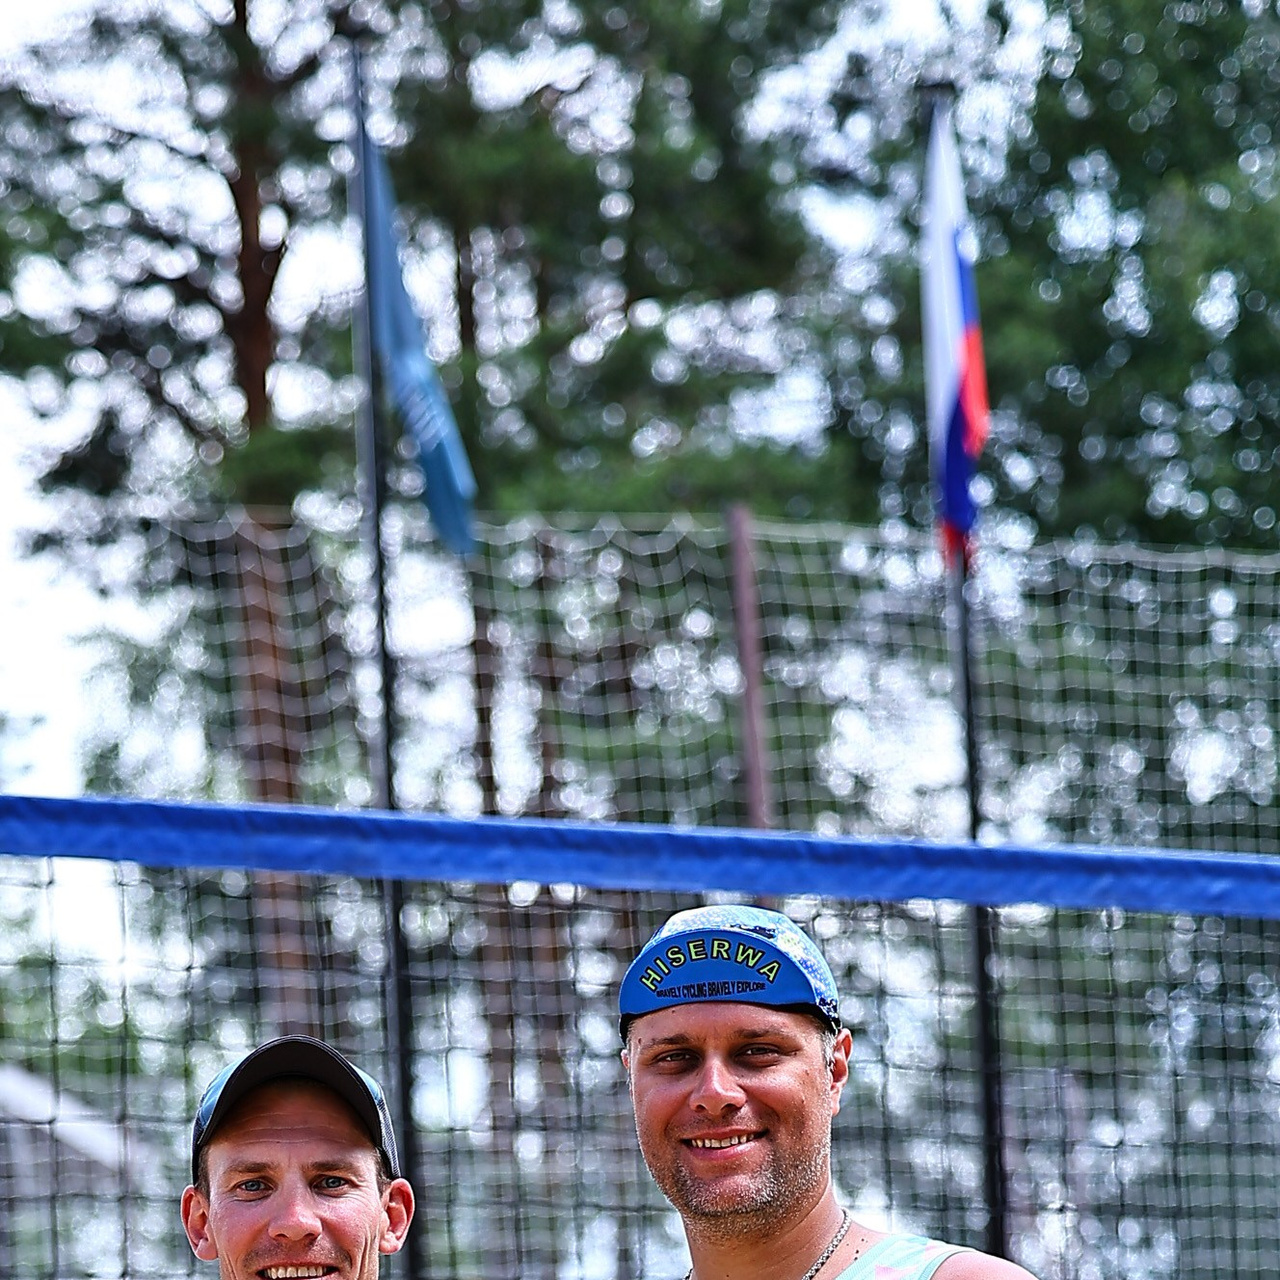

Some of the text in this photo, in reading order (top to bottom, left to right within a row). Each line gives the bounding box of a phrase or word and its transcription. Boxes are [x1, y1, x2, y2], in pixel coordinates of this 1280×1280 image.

[639, 938, 782, 991] HISERWA
[682, 982, 708, 998] CYCLING
[708, 981, 736, 997] BRAVELY
[736, 981, 766, 994] EXPLORE
